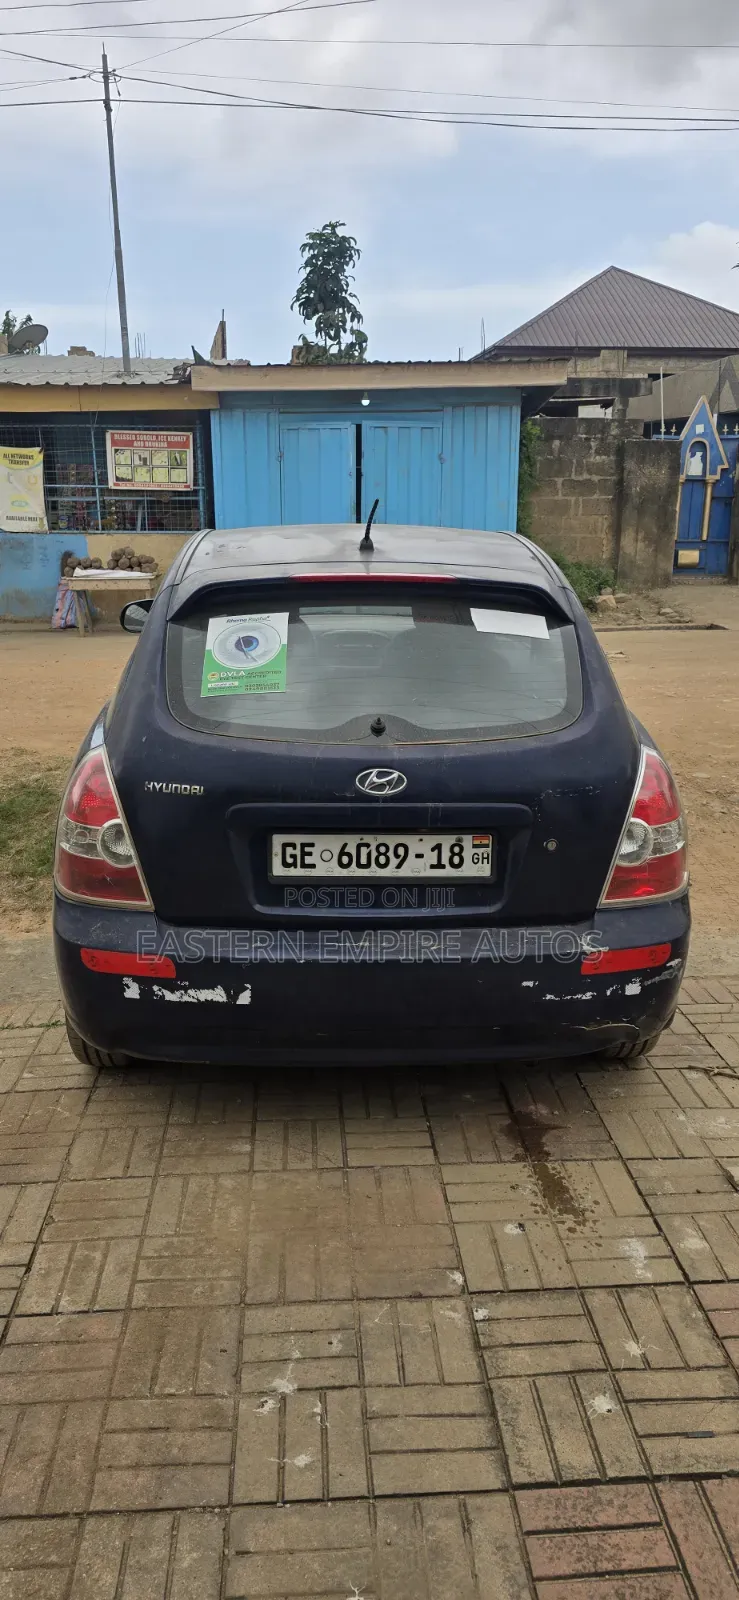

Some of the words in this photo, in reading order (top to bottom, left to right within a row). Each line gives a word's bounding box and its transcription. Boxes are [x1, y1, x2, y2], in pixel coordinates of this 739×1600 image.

[144, 781, 204, 795] HYUNDAI
[281, 842, 316, 869] GE
[337, 842, 465, 870] 6089-18
[471, 852, 490, 865] GH
